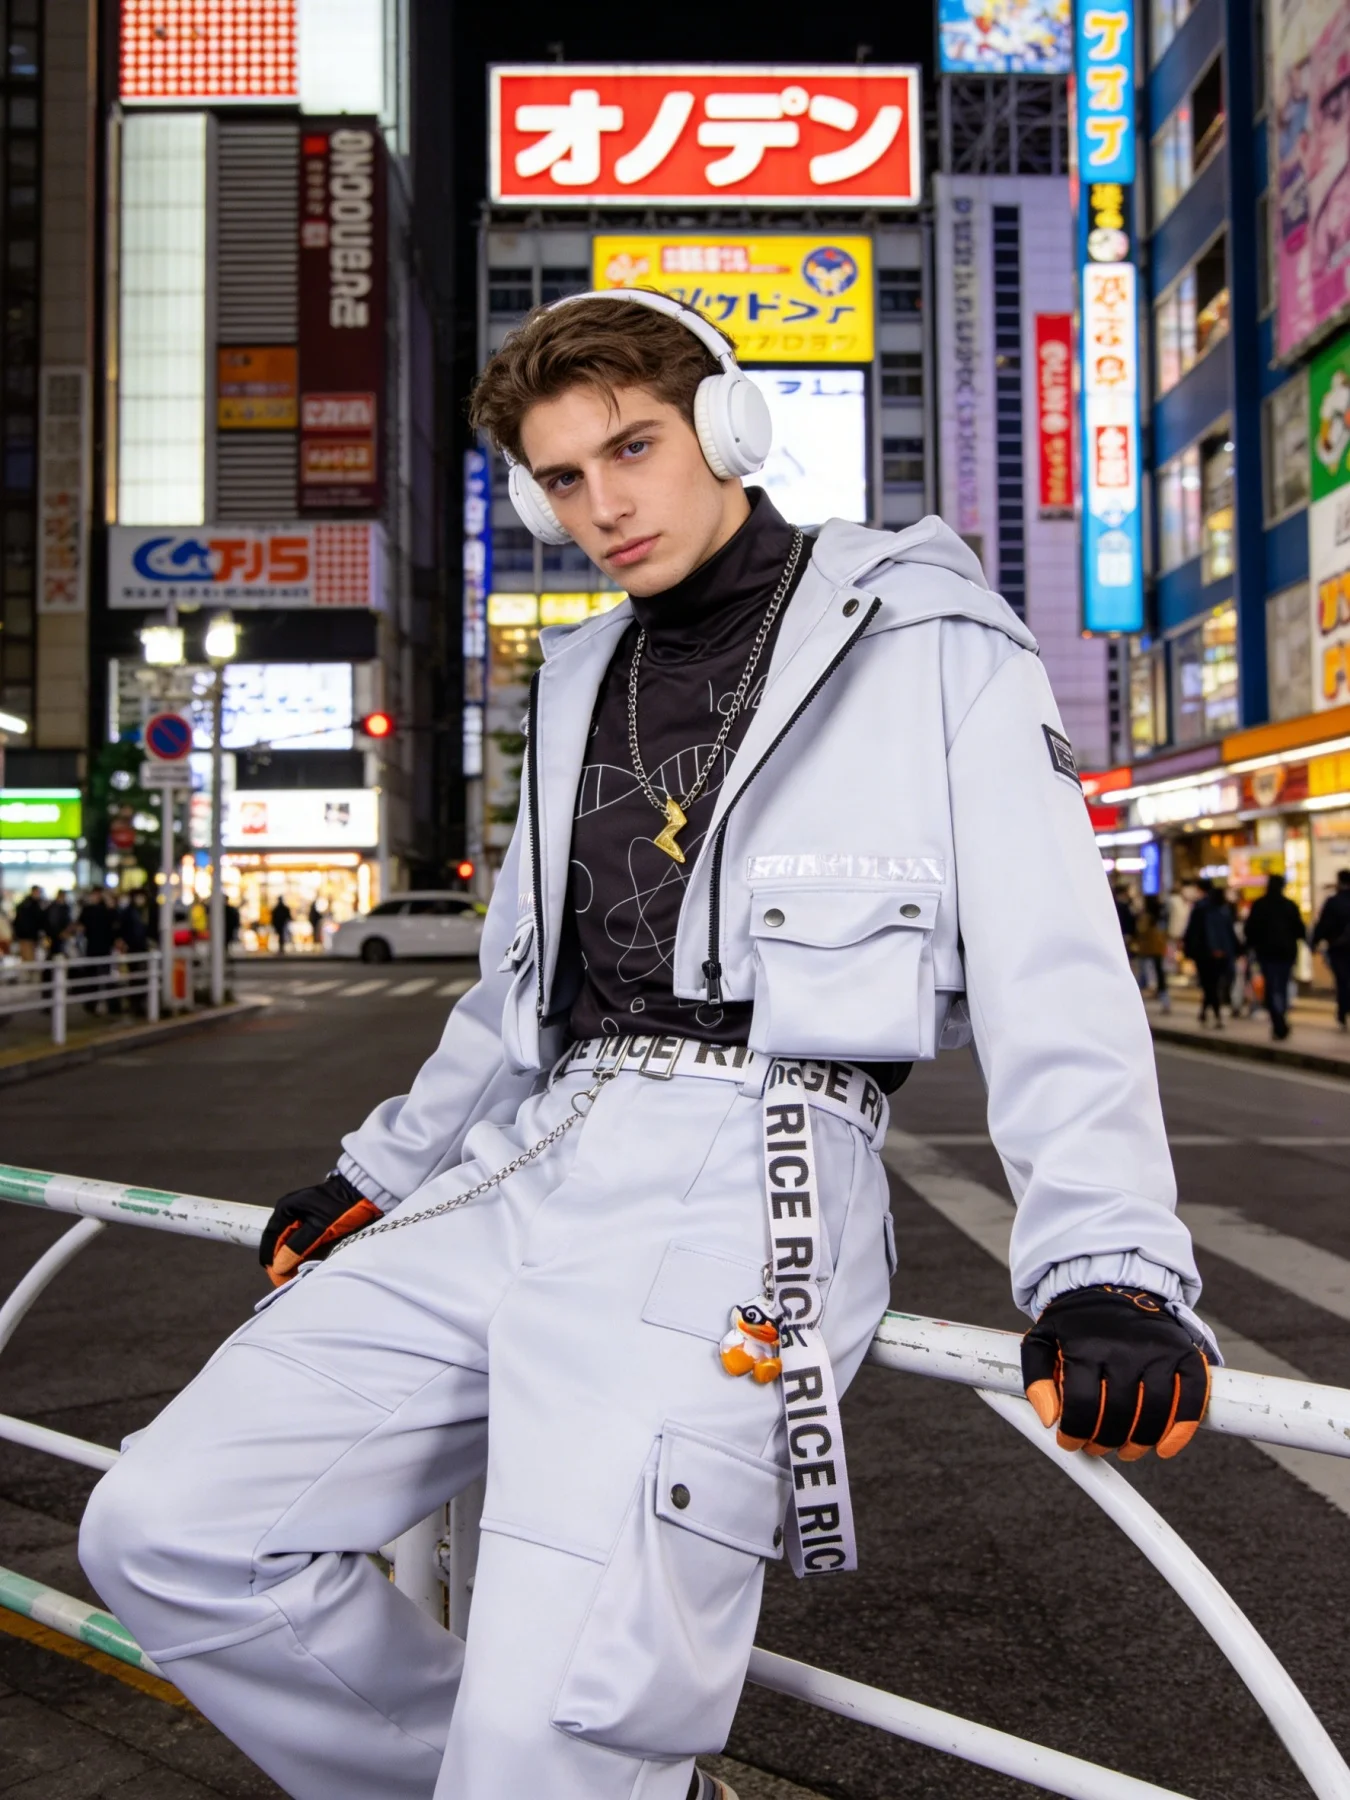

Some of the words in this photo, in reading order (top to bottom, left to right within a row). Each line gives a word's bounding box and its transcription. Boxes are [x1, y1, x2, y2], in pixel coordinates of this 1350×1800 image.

[514, 86, 903, 187] オノデン
[694, 1040, 755, 1069] RI
[766, 1103, 812, 1220] RICE
[783, 1365, 837, 1491] RICE
[798, 1502, 846, 1577] RIC
